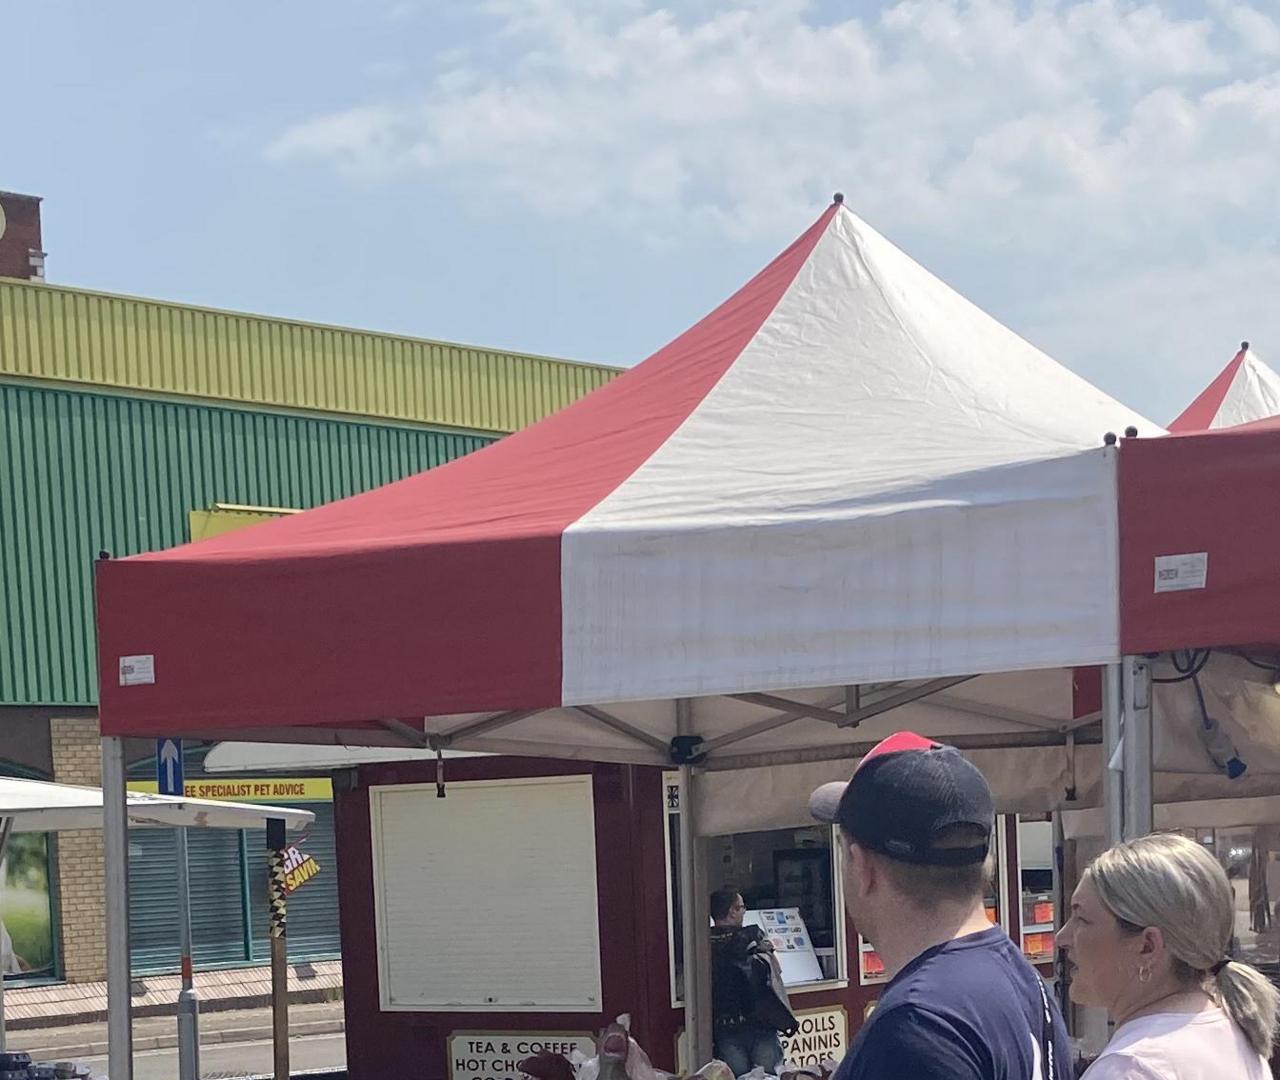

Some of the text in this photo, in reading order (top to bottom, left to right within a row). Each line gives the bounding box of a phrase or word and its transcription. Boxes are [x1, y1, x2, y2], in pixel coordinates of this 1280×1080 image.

[199, 785, 252, 798] SPECIALIST
[254, 784, 271, 797] PET
[273, 783, 305, 796] ADVICE
[468, 1041, 496, 1053] TEA
[501, 1042, 511, 1054] &
[782, 1032, 841, 1054] PANINIS
[456, 1059, 487, 1072] HOT
